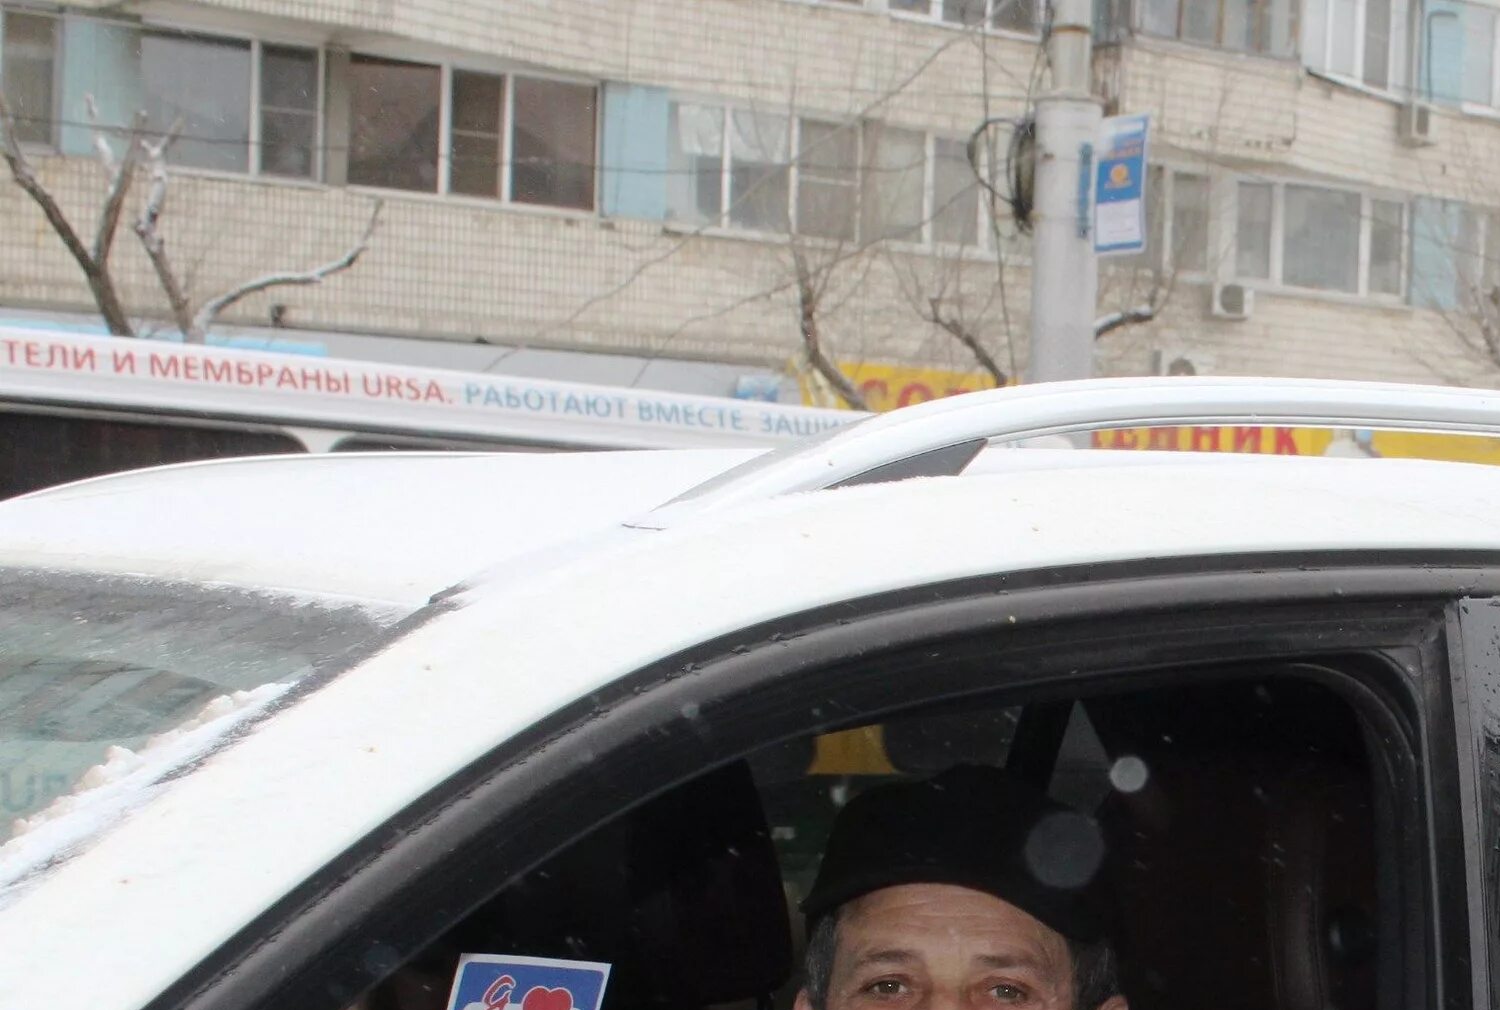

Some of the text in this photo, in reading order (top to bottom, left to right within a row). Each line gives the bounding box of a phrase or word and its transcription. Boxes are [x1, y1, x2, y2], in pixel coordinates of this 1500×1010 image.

[1, 339, 97, 371] ТЕЛИ
[112, 350, 136, 375] И
[149, 351, 351, 395] МЕМБРАНЫ
[362, 371, 454, 405] URSA.
[464, 381, 628, 419] РАБОТАЮТ
